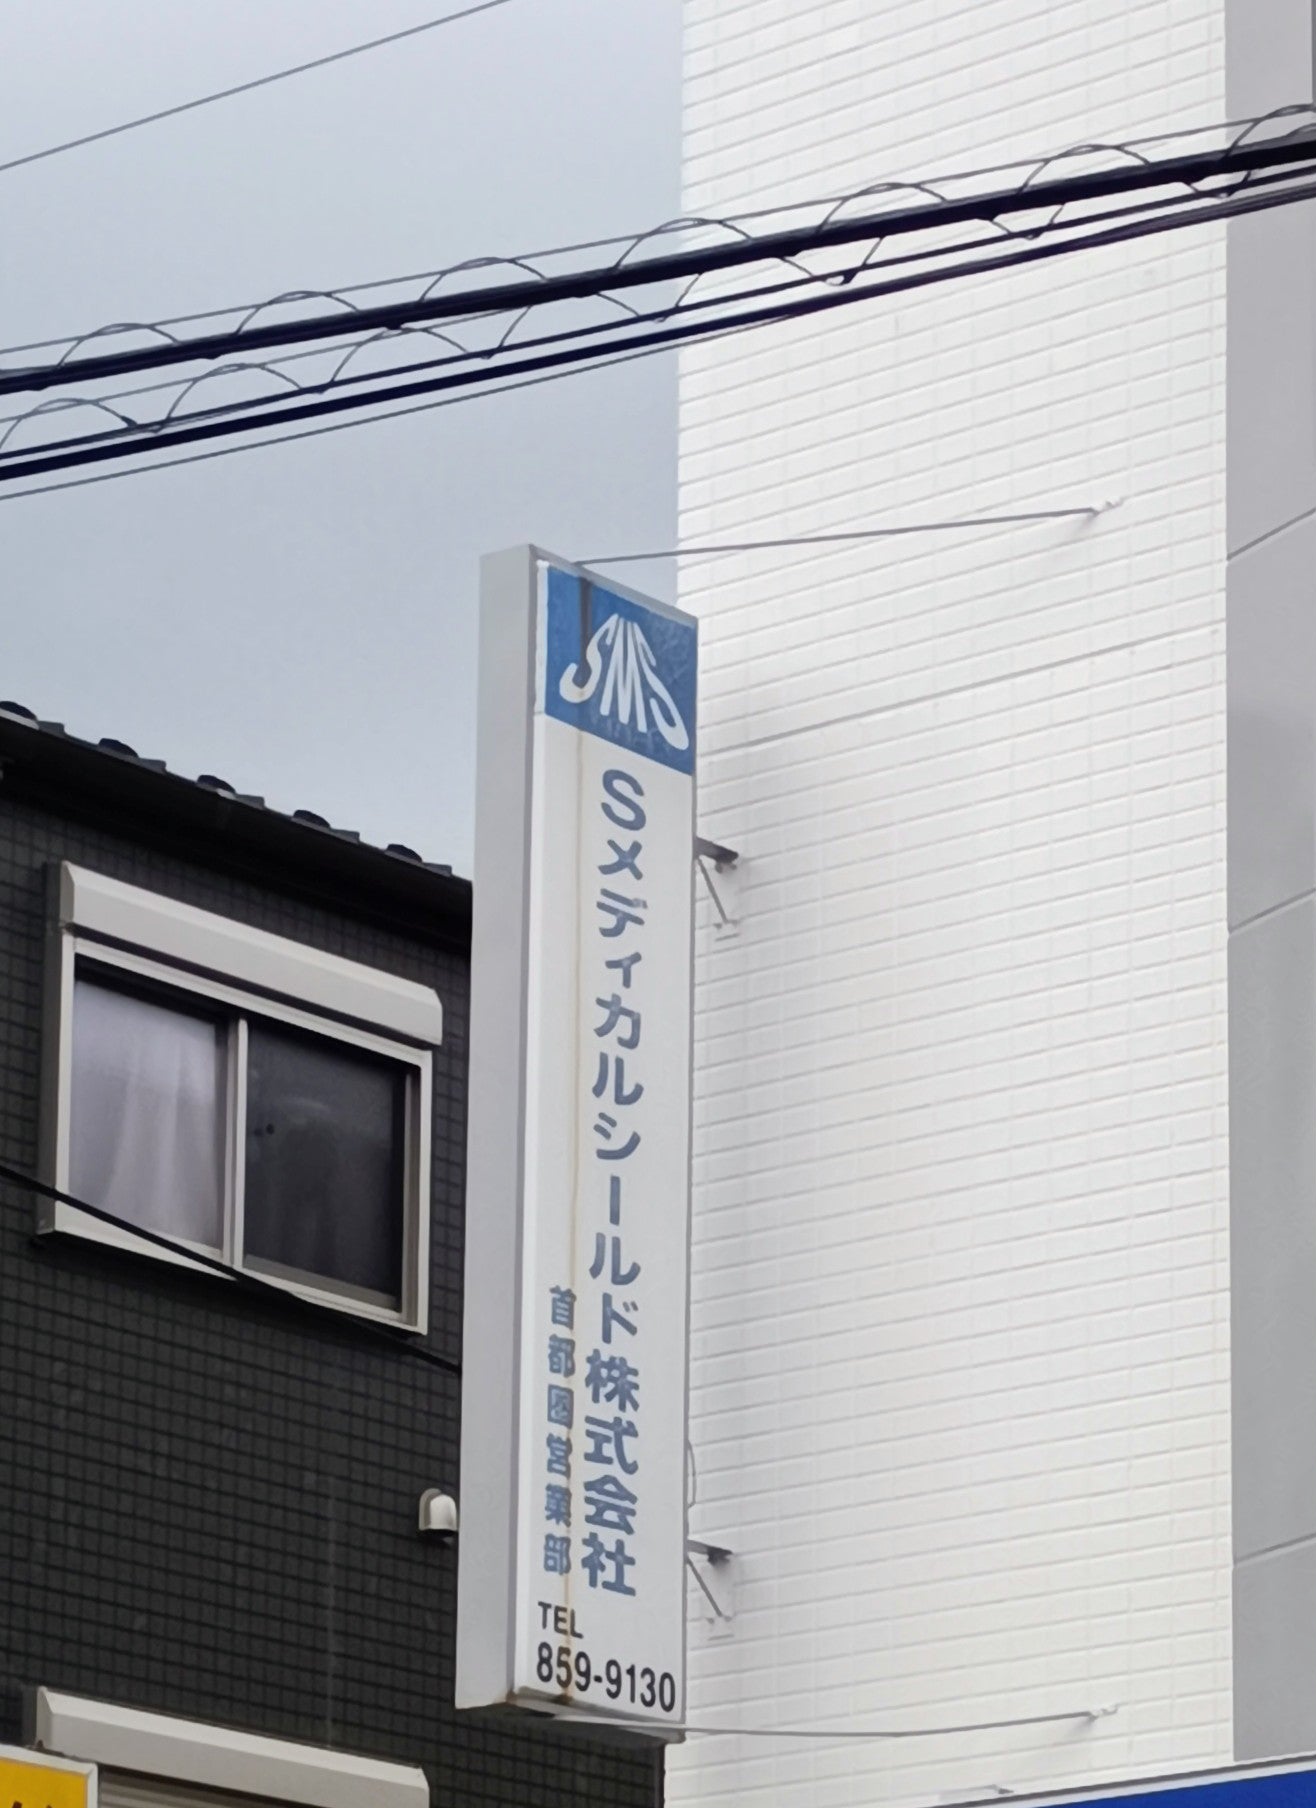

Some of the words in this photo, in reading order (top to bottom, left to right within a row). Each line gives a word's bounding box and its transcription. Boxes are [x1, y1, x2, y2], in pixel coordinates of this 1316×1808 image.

[559, 614, 690, 751] SMS
[580, 769, 647, 1598] Sメディカルシールド株式会社
[537, 1601, 584, 1640] TEL
[536, 1641, 676, 1713] 859-9130
